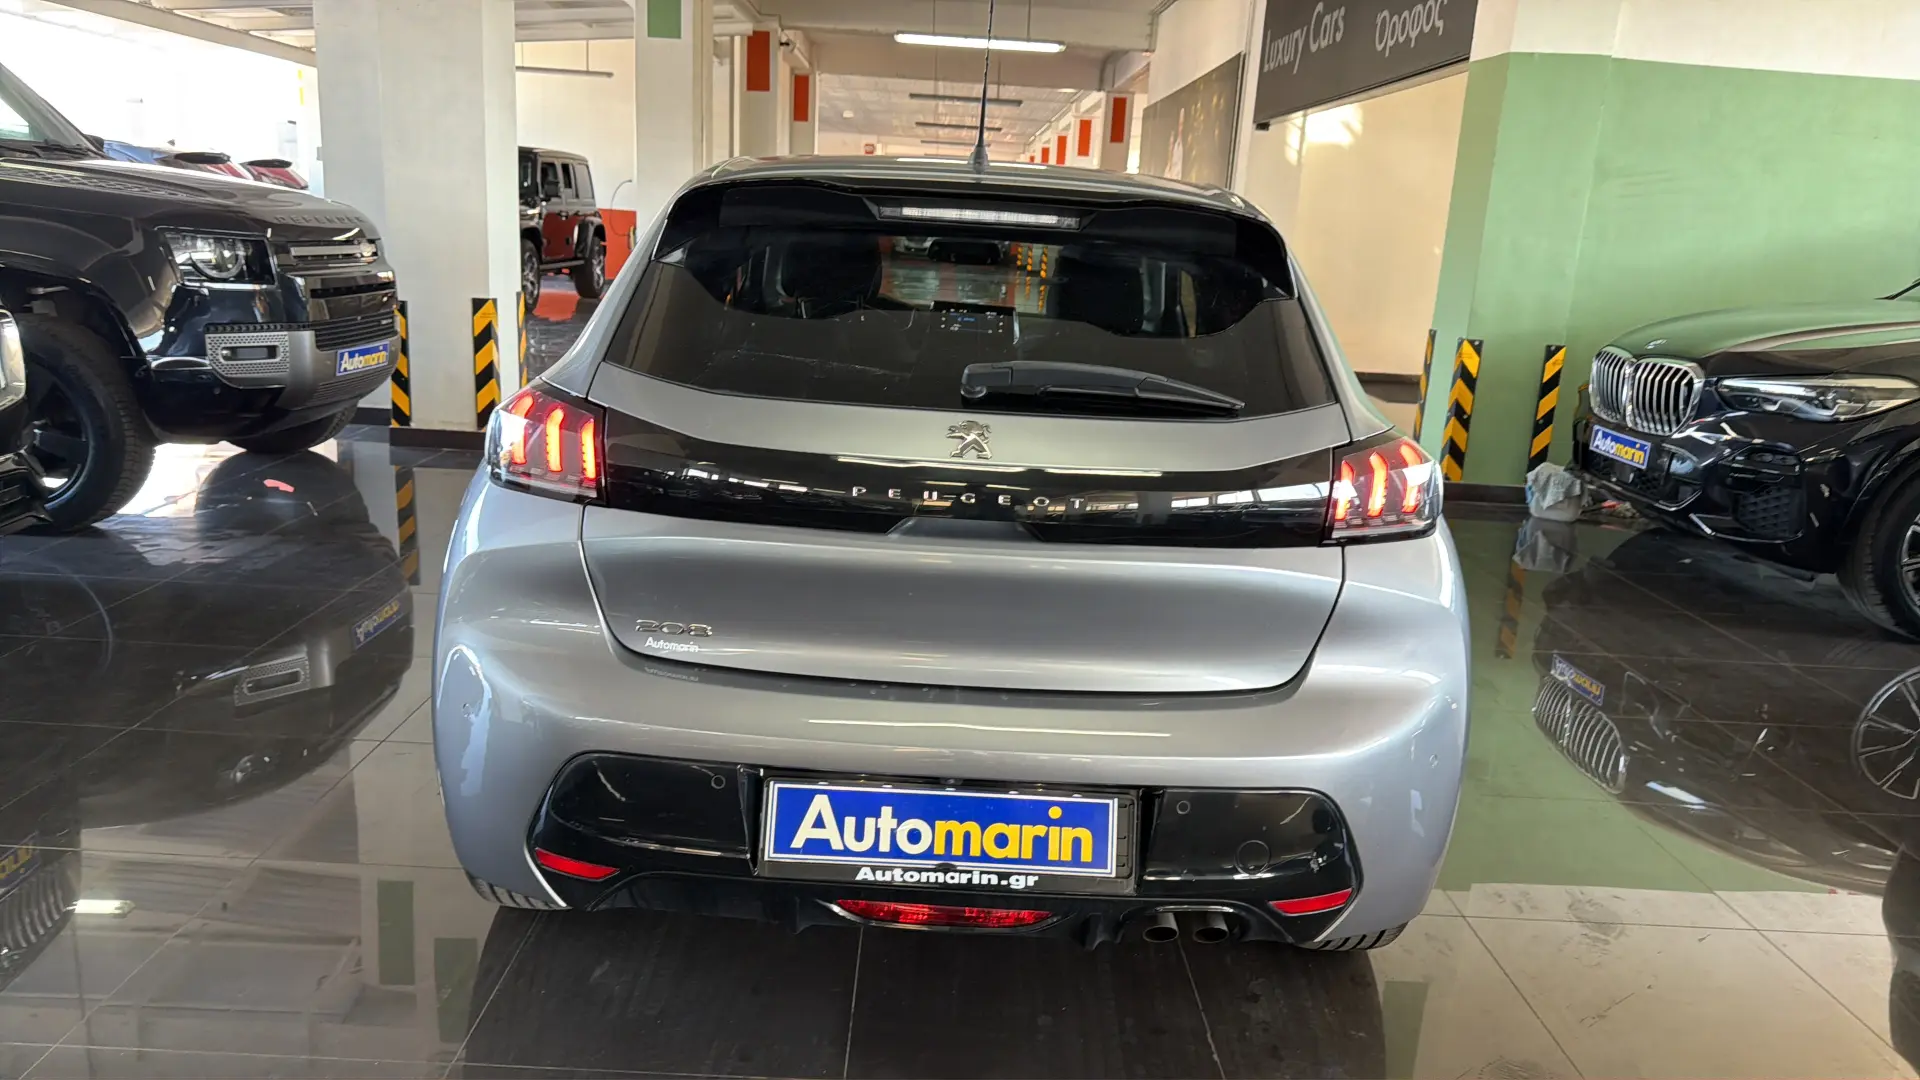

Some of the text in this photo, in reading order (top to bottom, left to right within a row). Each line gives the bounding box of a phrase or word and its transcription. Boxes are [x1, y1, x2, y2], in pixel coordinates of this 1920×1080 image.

[1263, 1, 1346, 75] Luxury Cars
[340, 345, 387, 372] Automarin
[1593, 430, 1645, 465] Automarin
[852, 486, 1085, 509] PEUGEOT
[635, 619, 713, 637] 208
[644, 636, 699, 653] Automarin
[790, 794, 1093, 863] Automarin
[855, 866, 1039, 889] Automarin.gr
